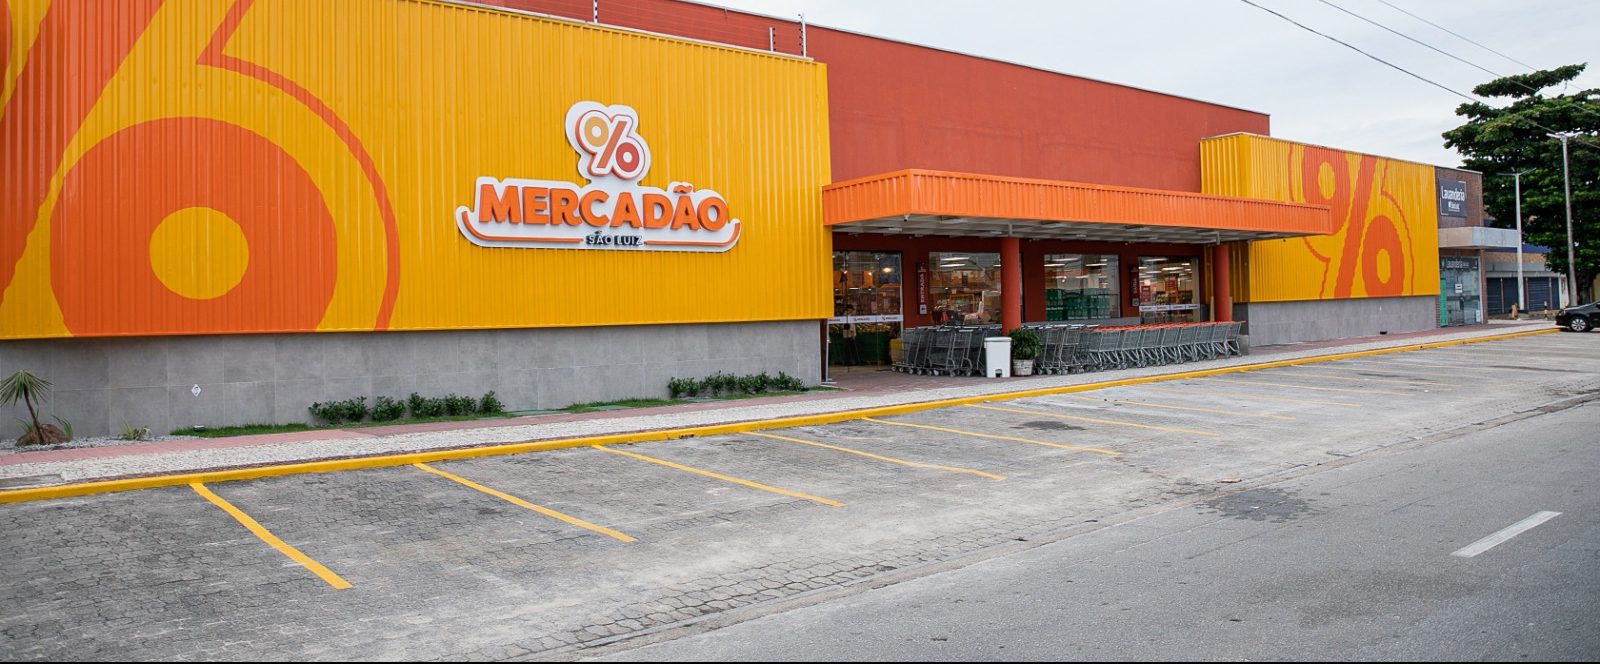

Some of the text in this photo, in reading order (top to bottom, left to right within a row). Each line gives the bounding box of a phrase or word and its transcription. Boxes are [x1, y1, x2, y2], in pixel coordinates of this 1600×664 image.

[478, 183, 730, 232] MERCADÃO
[586, 230, 644, 246] SÃO LUIZ
